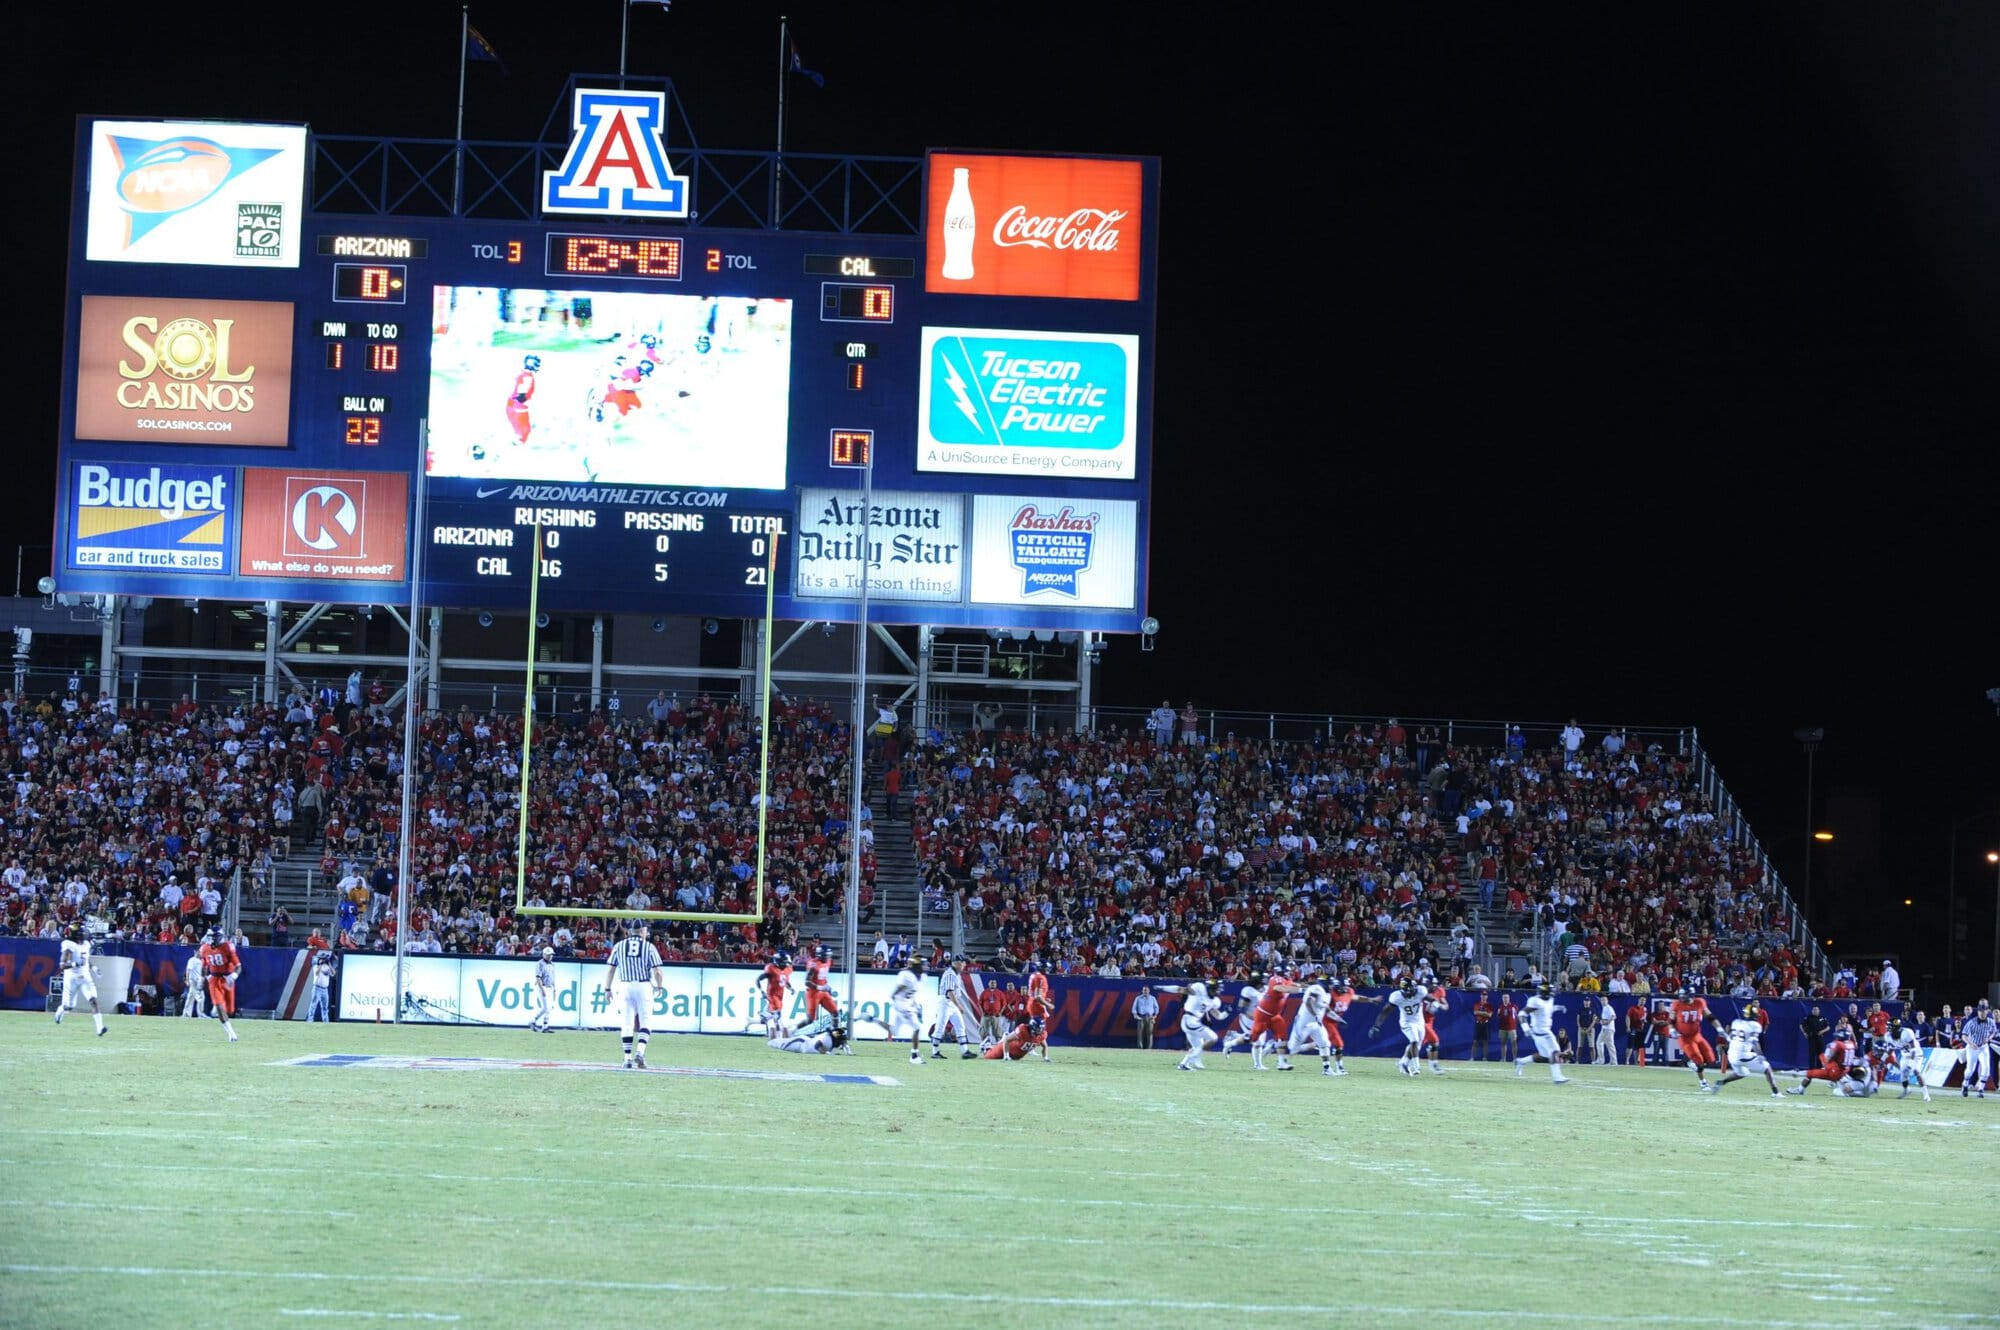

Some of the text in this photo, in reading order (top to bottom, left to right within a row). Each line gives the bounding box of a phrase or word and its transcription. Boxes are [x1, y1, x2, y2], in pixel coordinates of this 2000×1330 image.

[542, 87, 690, 218] A
[238, 216, 281, 229] PAC
[993, 205, 1128, 251] Coca-Cola
[237, 229, 280, 247] 10
[334, 236, 411, 257] ARIZONA
[471, 241, 522, 263] TOL 3
[567, 238, 679, 274] 12:49
[706, 249, 757, 271] 2 TOL
[841, 257, 876, 276] CAL
[362, 268, 388, 298] 0
[864, 289, 891, 318] 0
[323, 322, 346, 337] DWN
[367, 323, 397, 339] TO GO
[118, 316, 255, 382] SOL
[334, 343, 342, 369] 1
[374, 345, 397, 370] 10
[846, 342, 866, 357] QTR
[980, 350, 1081, 380] Tucson
[856, 364, 863, 389] 1
[117, 382, 255, 412] CASINOS
[989, 379, 1107, 407] Electric
[343, 398, 384, 412] BALL ON
[137, 419, 232, 432] SOLCASINOS.COM
[346, 418, 380, 444] 22
[1000, 408, 1105, 433] Power
[834, 433, 869, 463] 07
[927, 450, 1123, 471] A UniSource Energy Company
[79, 466, 226, 520] Budget
[509, 485, 727, 507] ARIZONAATHLETICS.COM
[514, 508, 596, 527] RUSHING
[624, 512, 704, 531] PASSING
[818, 496, 942, 529] Arizona
[1012, 507, 1097, 531] Bashas'
[729, 516, 787, 535] TOTAL
[433, 527, 765, 556] ARIZONA 0 0 0
[799, 531, 959, 570] Daily Star
[1017, 534, 1086, 546] OFFICIAL
[78, 552, 219, 567] car and truck sales
[1016, 546, 1086, 558] TAILGATE
[1016, 557, 1085, 566] HEADQUARTERS
[252, 560, 393, 577] What else do you need?
[477, 557, 767, 585] CAL 16 5 21
[1028, 573, 1073, 583] ARIZONA
[800, 573, 957, 595] It's a Tucson thing.
[69, 678, 79, 690] 27
[608, 698, 620, 710] 28
[1146, 718, 1157, 730] 29
[934, 900, 949, 910] 29
[1682, 1010, 1698, 1023] 77
